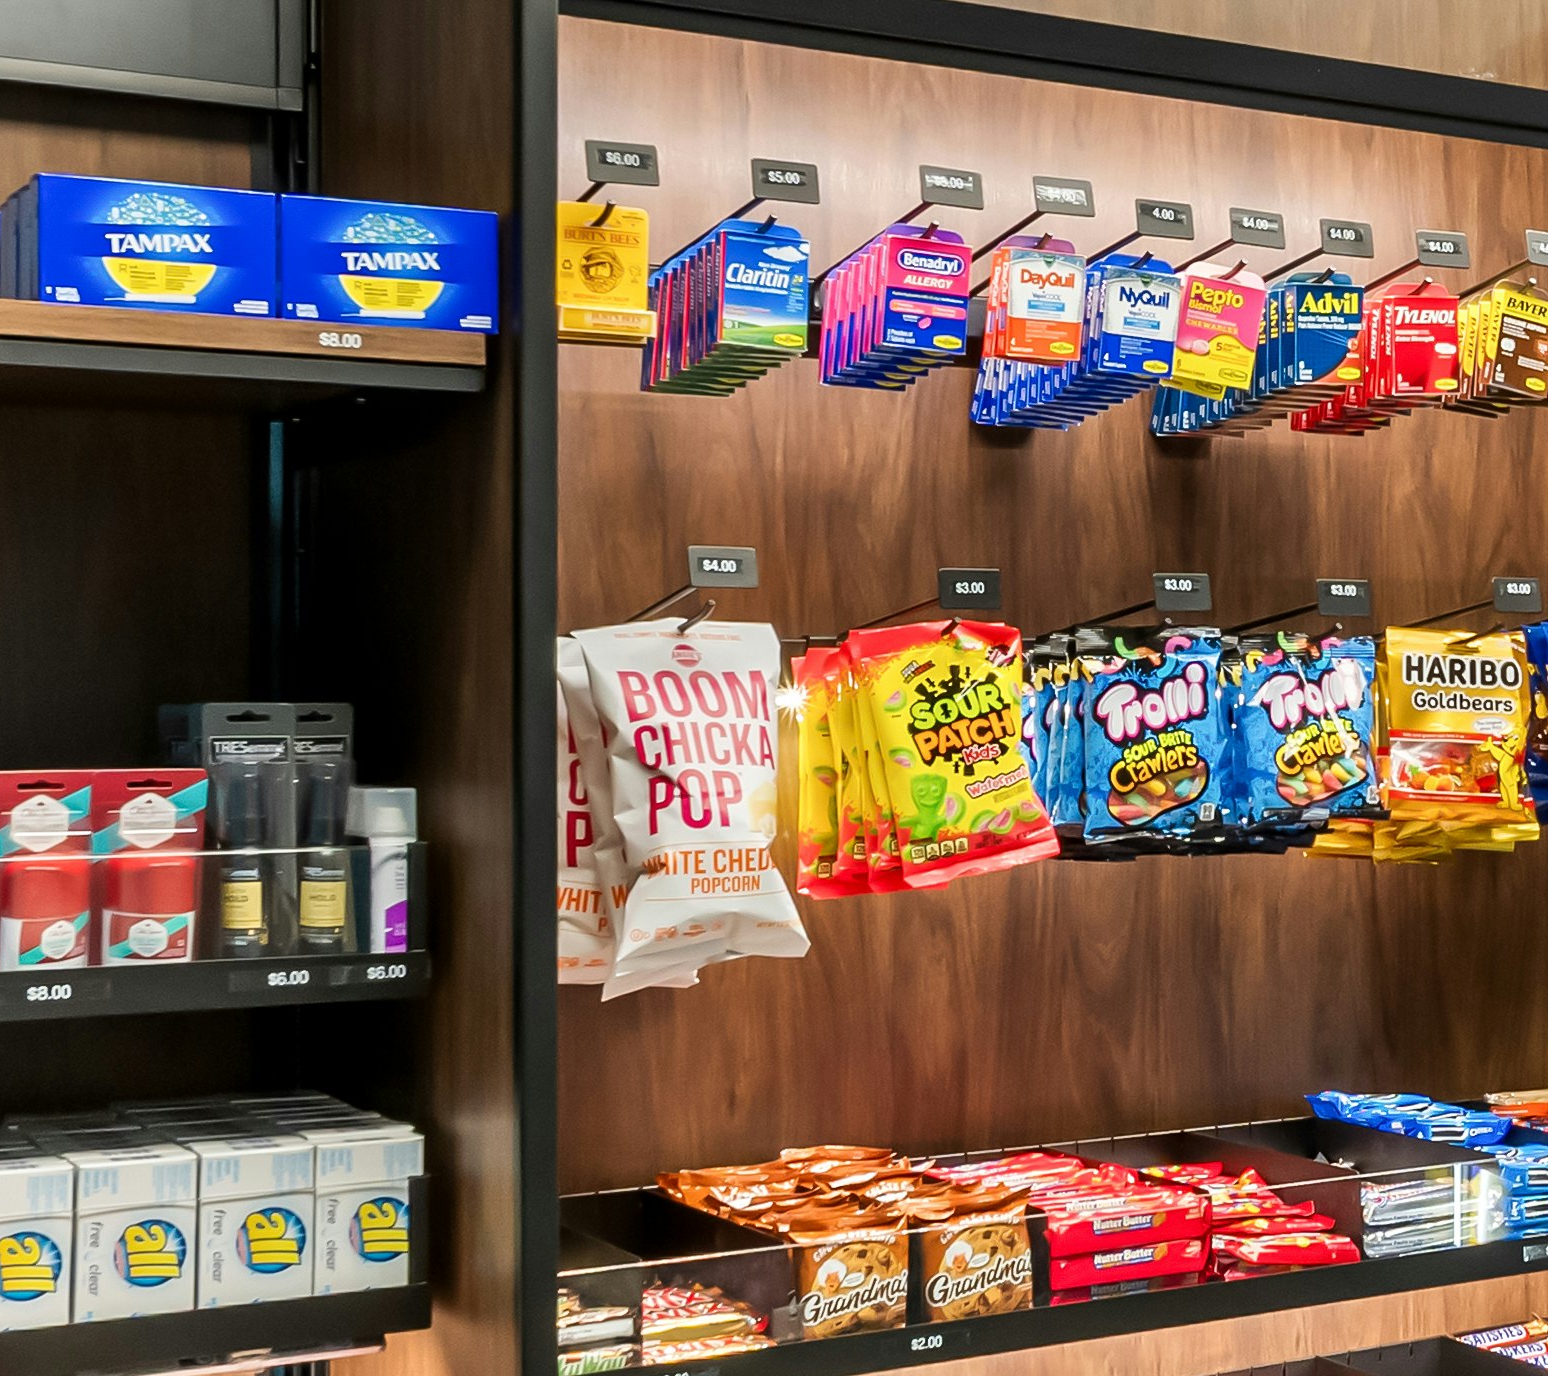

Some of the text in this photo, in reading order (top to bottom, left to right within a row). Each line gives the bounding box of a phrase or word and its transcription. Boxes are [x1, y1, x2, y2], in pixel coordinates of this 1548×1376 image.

[767, 170, 799, 185] $5.00
[105, 233, 213, 253] TAMPAX
[564, 228, 640, 245] BURT'S BEES
[341, 252, 441, 271] TAMPAX
[904, 251, 958, 273] Benadryl
[726, 263, 789, 288] Claritin
[903, 273, 952, 290] ALLERGY
[1020, 268, 1075, 289] DayQuil
[1120, 285, 1170, 310] NyQuil
[1191, 282, 1244, 310] Pepto
[1299, 291, 1359, 314] Advil
[1395, 307, 1455, 325] TYLENOL
[1507, 297, 1548, 318] BAYER
[319, 332, 362, 349] $8.00
[702, 559, 737, 573] $4.00
[956, 581, 985, 594] $3.00
[1165, 579, 1191, 591] $3.00
[1331, 585, 1356, 597] $3.00
[1507, 584, 1531, 595] $3.00
[1404, 655, 1520, 687] HARIBO
[617, 670, 771, 723] BOOM
[1097, 663, 1207, 741] Trolli
[1413, 693, 1514, 713] Goldbears
[911, 684, 1005, 731] SOUR
[634, 722, 776, 769] CHICKA
[914, 711, 1015, 760] PATCH
[1124, 731, 1192, 764] SOUR BRITE
[1111, 745, 1198, 793] Crawlers
[648, 770, 743, 835] POP
[691, 876, 761, 894] POPCORN
[268, 970, 309, 986] $6.00
[367, 964, 406, 980] $6.00
[27, 984, 72, 1001] $8.00
[1094, 1214, 1152, 1231] Nutter Butter
[911, 1335, 942, 1350] $2.00
